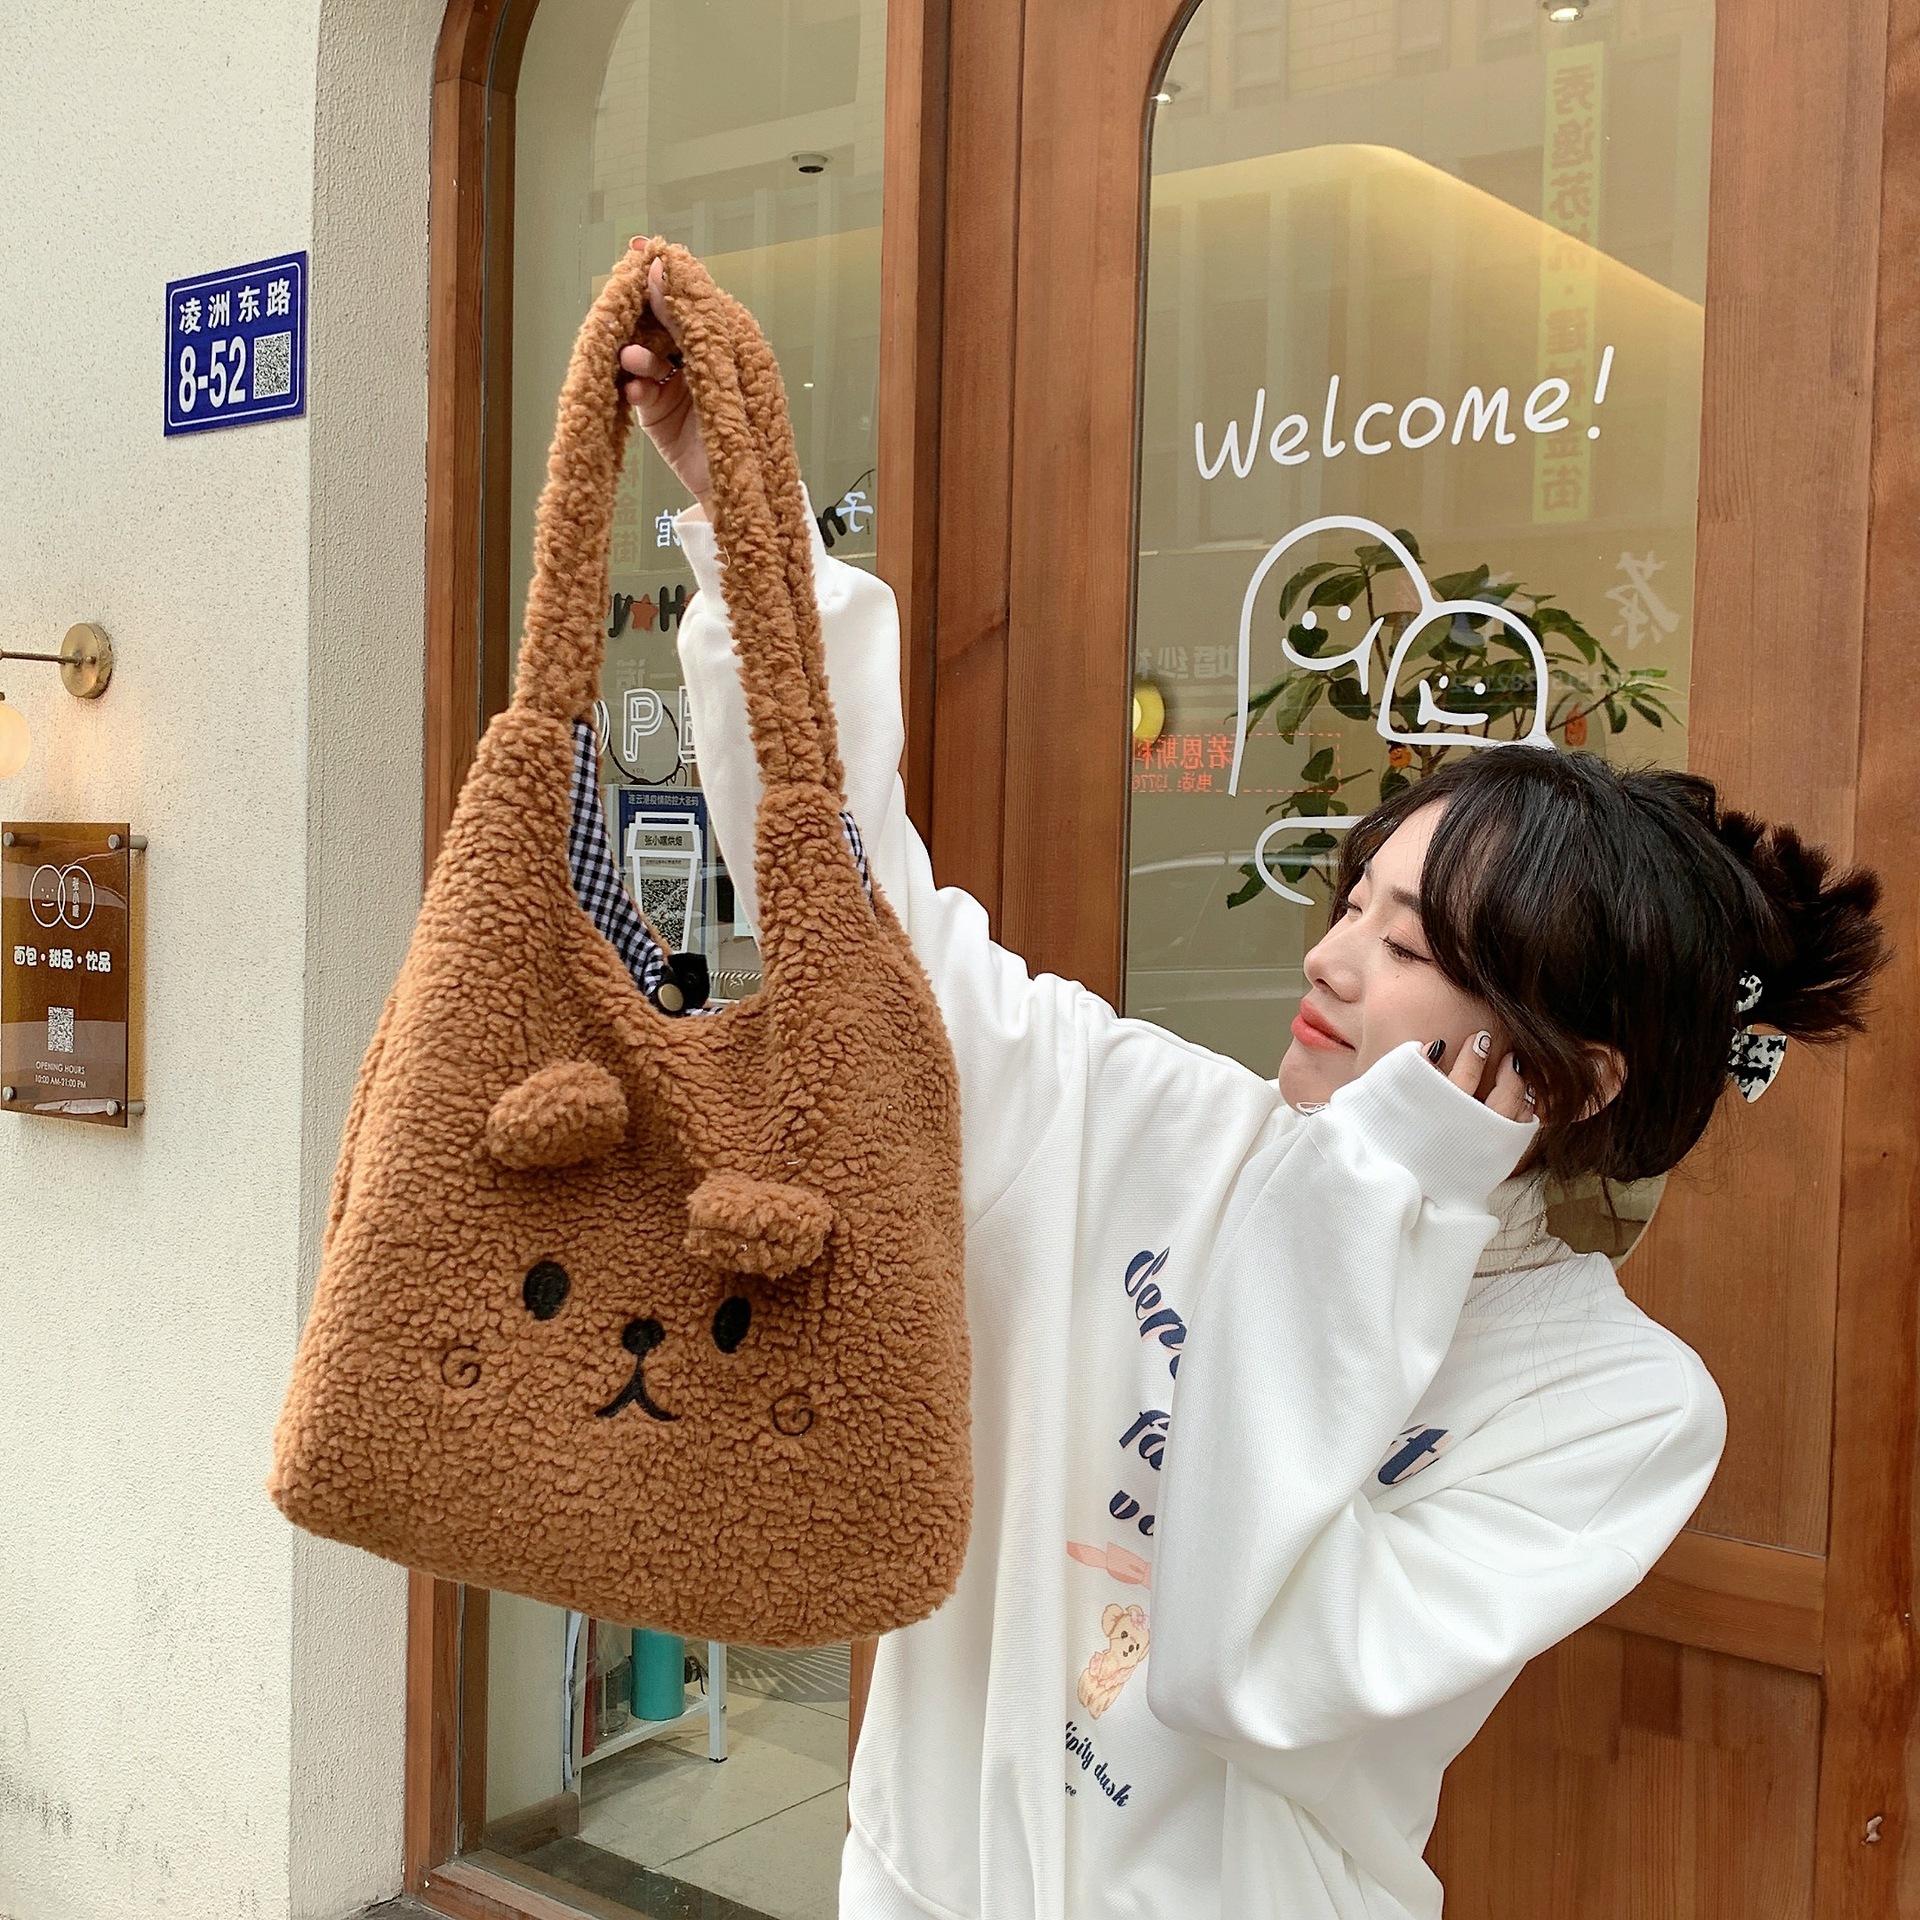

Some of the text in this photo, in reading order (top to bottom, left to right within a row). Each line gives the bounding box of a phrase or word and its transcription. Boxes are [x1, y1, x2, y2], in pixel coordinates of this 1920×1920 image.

[178, 278, 292, 335] 凌洲东路
[178, 335, 247, 414] 8-52
[1195, 345, 1615, 480] Welcome!
[34, 1074, 50, 1085] 10:00
[77, 1079, 88, 1089] PM
[35, 1060, 85, 1075] OPENING HOURS
[1094, 1762, 1132, 1808] dusk
